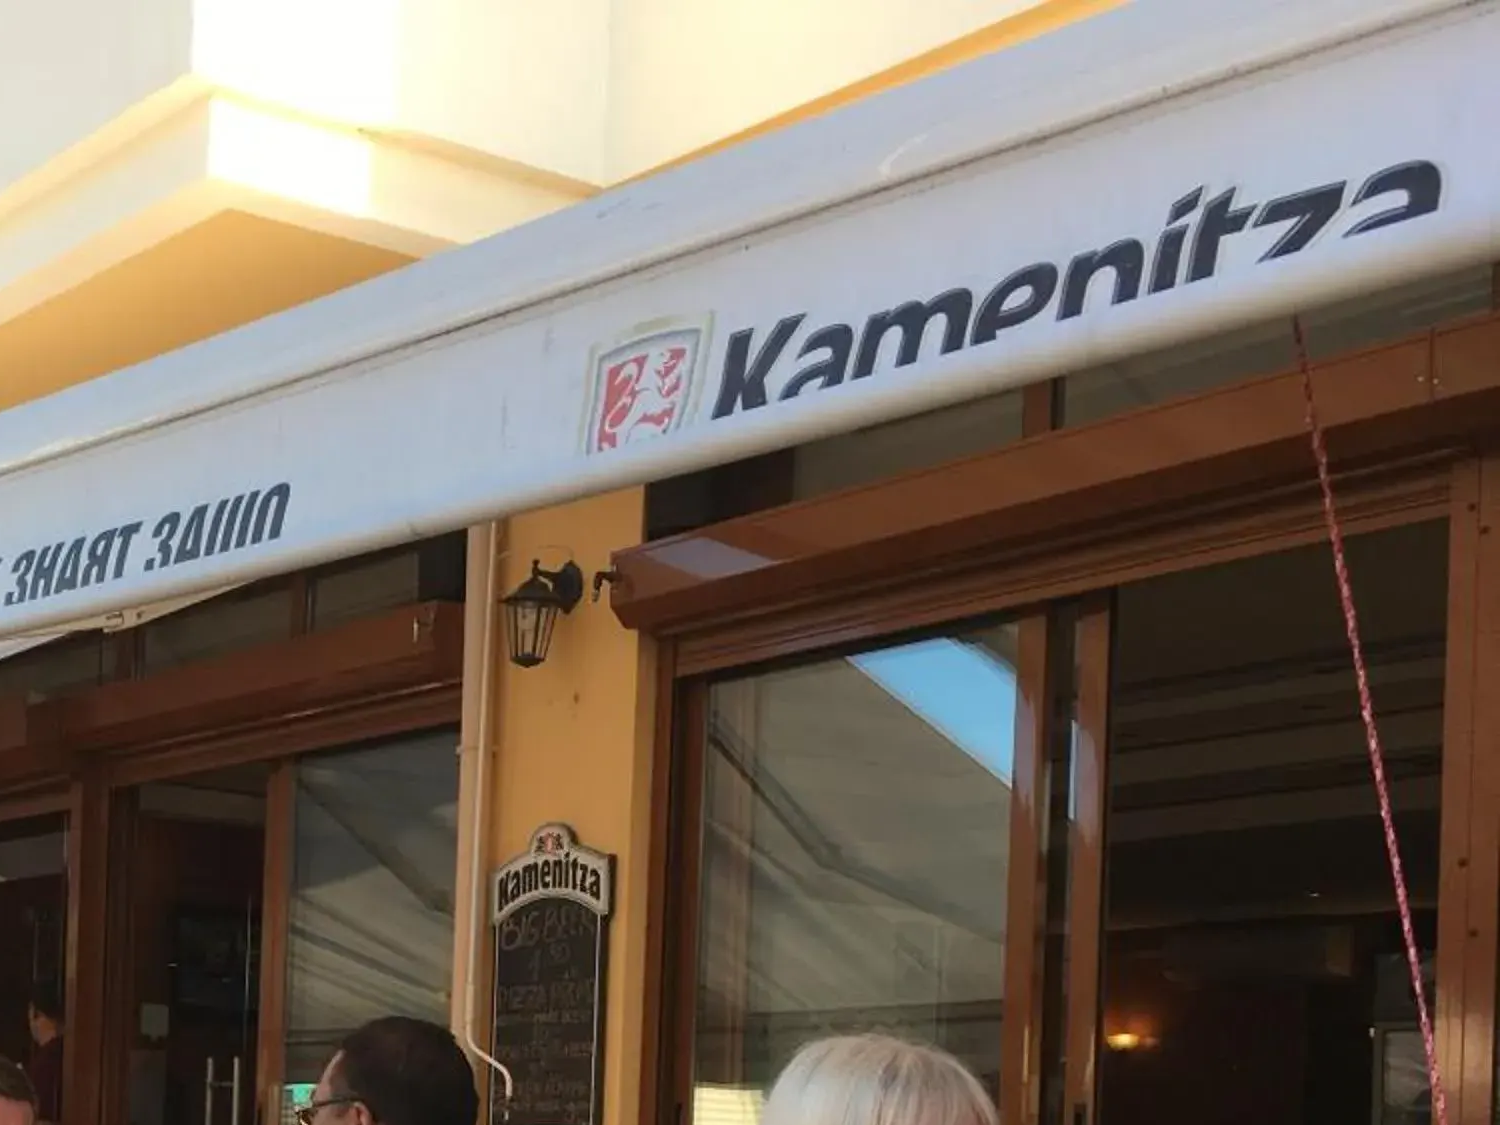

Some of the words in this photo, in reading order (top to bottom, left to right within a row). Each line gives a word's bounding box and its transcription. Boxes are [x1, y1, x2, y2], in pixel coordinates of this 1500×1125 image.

[710, 158, 1443, 421] Kamenitza
[3, 520, 144, 606] ЗНАЯТ
[499, 851, 601, 908] Kamenitza
